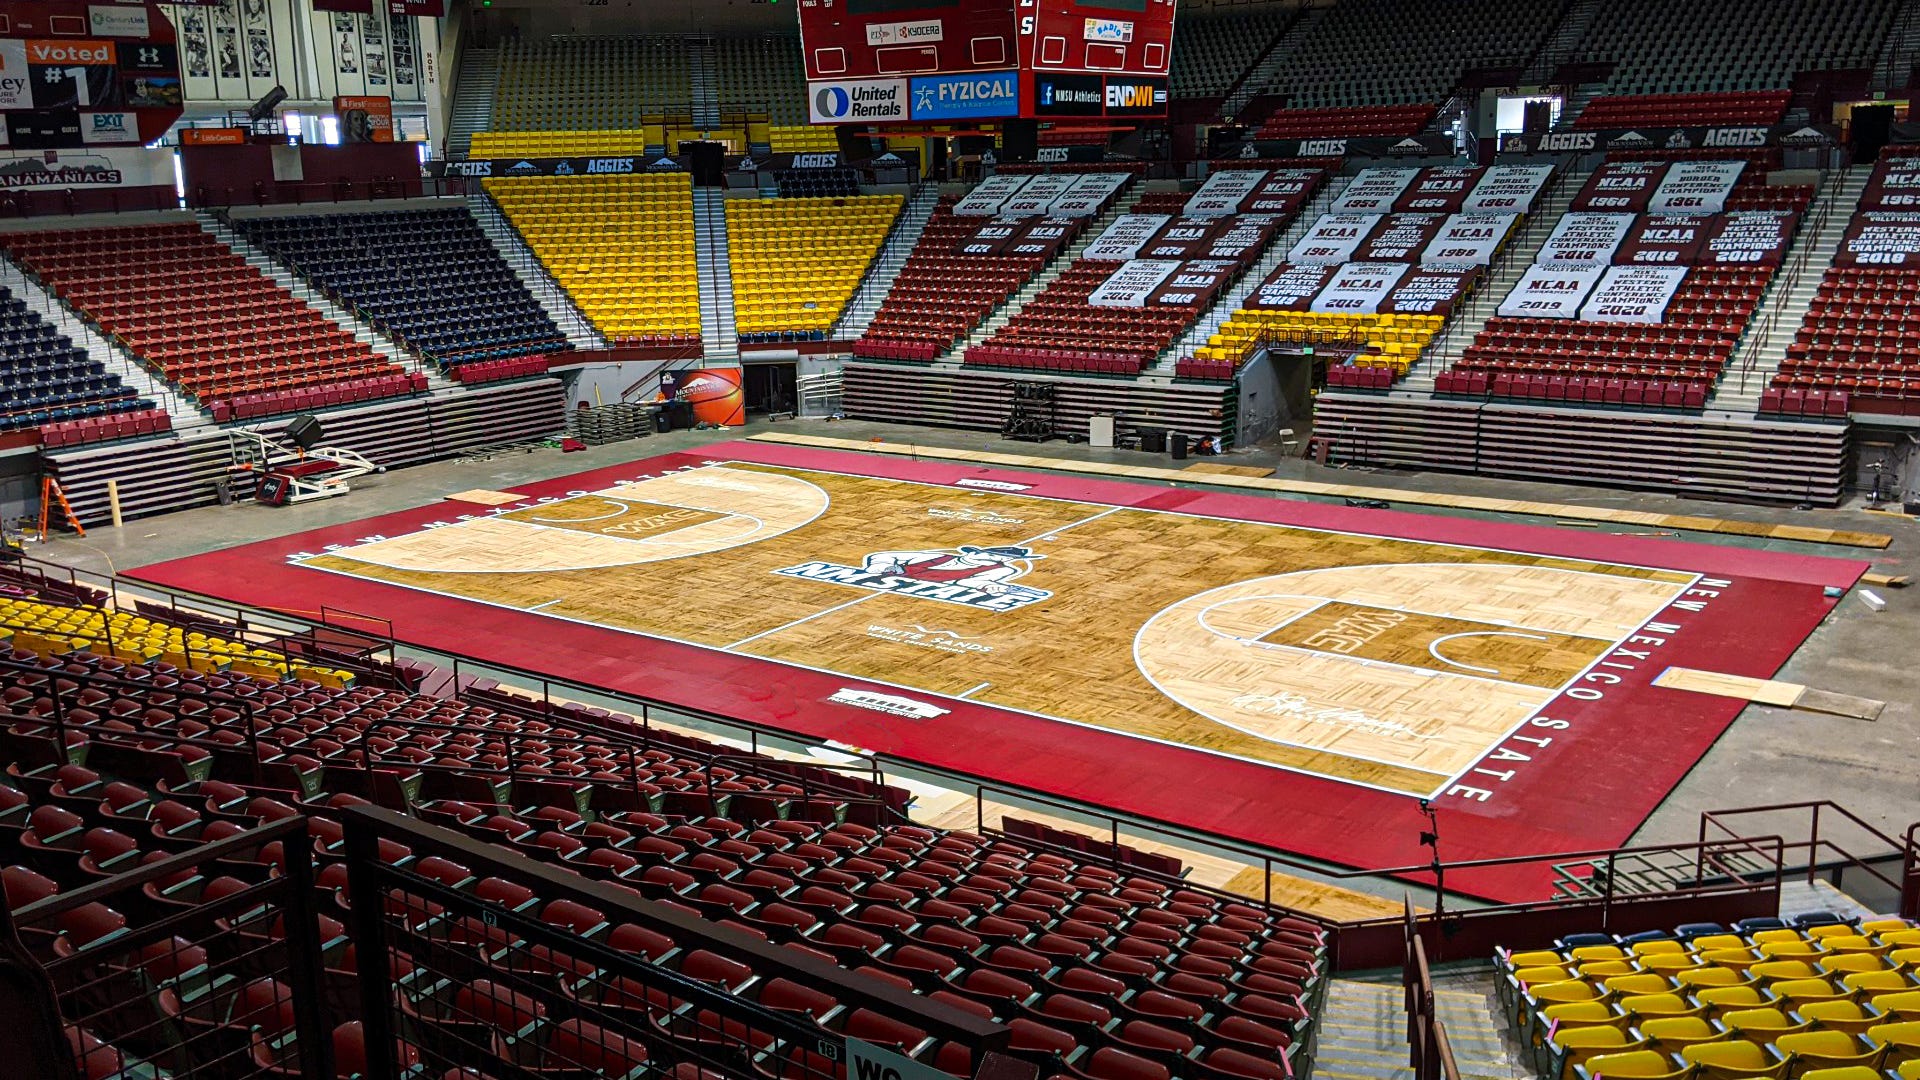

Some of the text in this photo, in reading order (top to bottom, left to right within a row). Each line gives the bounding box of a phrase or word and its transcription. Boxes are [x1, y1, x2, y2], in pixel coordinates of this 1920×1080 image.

[907, 25, 940, 37] KYOCERA
[1096, 23, 1122, 37] RADIO
[34, 45, 109, 61] Voted
[45, 67, 90, 106] #1
[939, 80, 1014, 101] FYZICAL
[852, 85, 897, 102] United
[1056, 89, 1101, 103] NMSU Athletics
[852, 101, 901, 117] Rentals
[93, 114, 124, 127] EXIT
[1537, 132, 1598, 151] AGGIES
[1702, 127, 1768, 147] AGGIES
[1297, 140, 1347, 157] AGGIES
[1037, 147, 1069, 163] GGIES
[586, 159, 633, 173] AGGIES
[792, 153, 837, 169] AGGIES
[0, 171, 118, 187] ANAMANIACS
[1596, 178, 1646, 187] NCAA
[1262, 183, 1304, 192] NCAA
[1419, 180, 1464, 190] NCAA
[1196, 200, 1229, 209] 1952
[1251, 200, 1286, 209] 1952
[1344, 200, 1380, 208] 1959
[1409, 199, 1447, 207] 1959
[1477, 198, 1517, 207] 1960
[1588, 197, 1631, 207] 1960
[1665, 197, 1704, 207] 1961
[977, 227, 1013, 236] NCAA
[1028, 227, 1065, 236] NCAA
[1165, 229, 1205, 238] NCAA
[1315, 228, 1358, 237] NCAA
[1447, 228, 1494, 238] NCAA
[1640, 229, 1695, 240] NCAA
[1013, 244, 1046, 252] 1975
[1095, 246, 1128, 254] 1977
[1151, 246, 1186, 255] 1979
[1709, 242, 1778, 250] CHAMPIONS
[1847, 244, 1920, 253] CHAMPIONS
[1209, 248, 1246, 256] 1987
[1302, 247, 1340, 256] 1987
[1437, 249, 1478, 257] 1988
[1553, 250, 1597, 260] 2018
[1633, 251, 1680, 262] 2018
[1715, 251, 1763, 262] 2018
[1856, 253, 1905, 264] 2018
[1173, 275, 1216, 284] NCAA
[1337, 280, 1383, 288] NCAA
[1527, 280, 1580, 290] NCAA
[1101, 292, 1135, 300] 2019
[1160, 293, 1197, 303] 2019
[1259, 289, 1313, 297] CHAMPIONS
[1259, 296, 1298, 305] 2019
[1325, 299, 1366, 308] 2019
[1518, 301, 1562, 310] 2019
[1594, 296, 1662, 305] CHAMPIONS
[1394, 301, 1437, 311] 2019
[1597, 305, 1647, 316] 2020
[286, 460, 723, 562] NEW MEXICO STATE
[860, 577, 1043, 611] STATE
[1671, 577, 1732, 612] NEW
[867, 624, 994, 653] WHITE SANDS
[1566, 621, 1681, 701] MEXICO
[1446, 715, 1570, 802] STATE
[819, 1041, 835, 1058] 18
